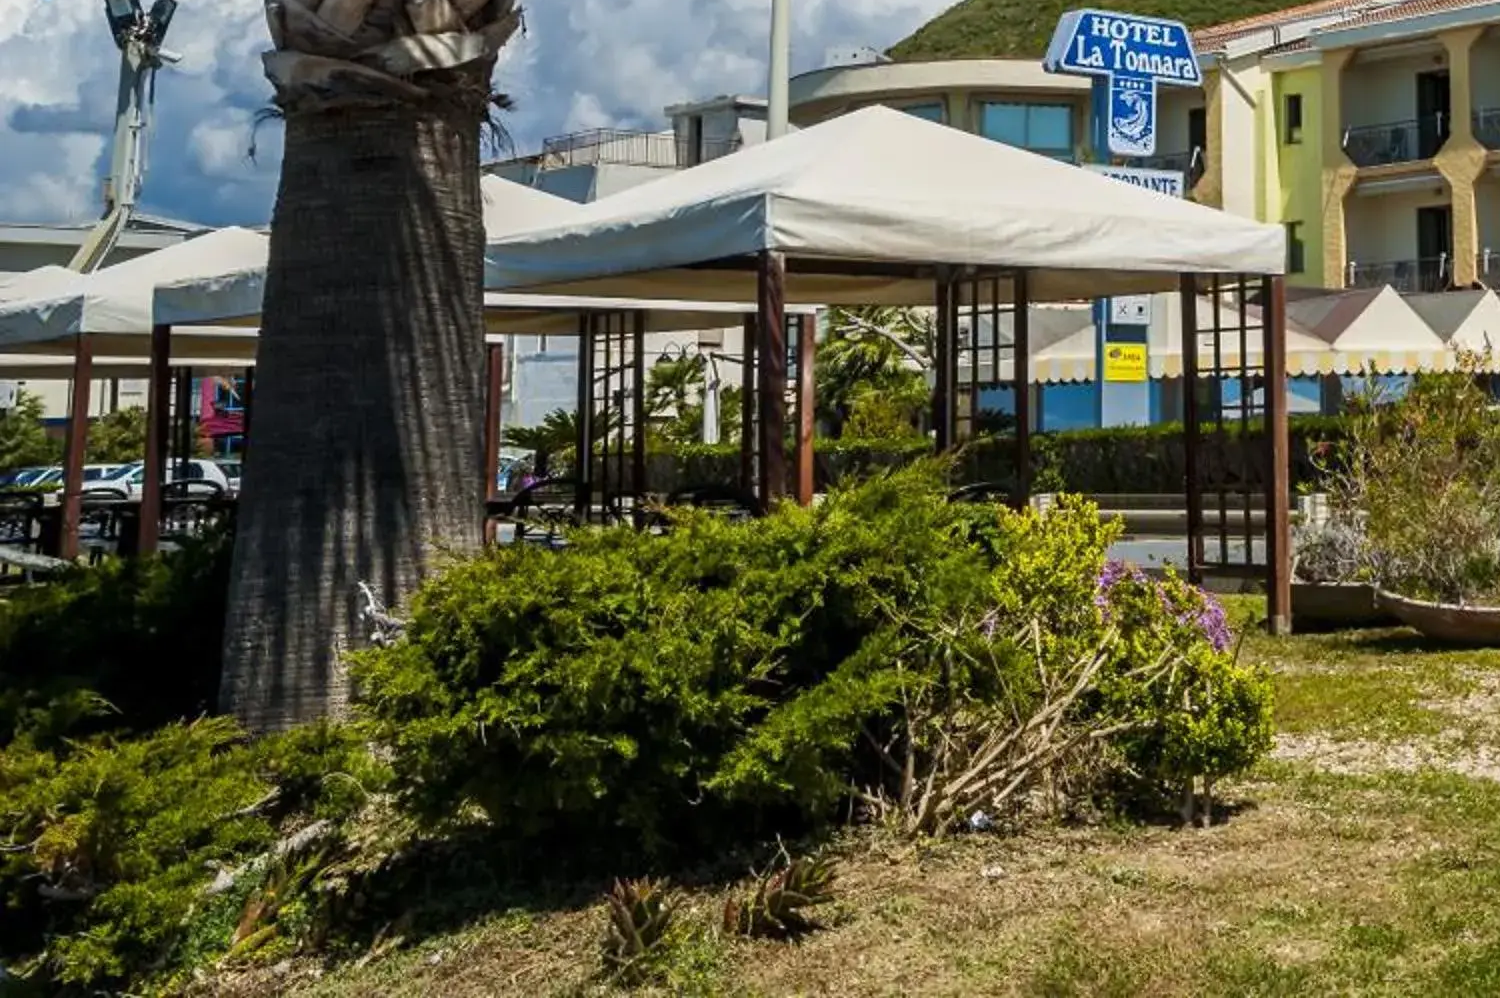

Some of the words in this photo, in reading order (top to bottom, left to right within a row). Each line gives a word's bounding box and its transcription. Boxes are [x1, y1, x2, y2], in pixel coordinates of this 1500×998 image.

[1091, 17, 1177, 47] HOTEL
[1076, 35, 1105, 67] La
[1109, 39, 1196, 79] Tonnara
